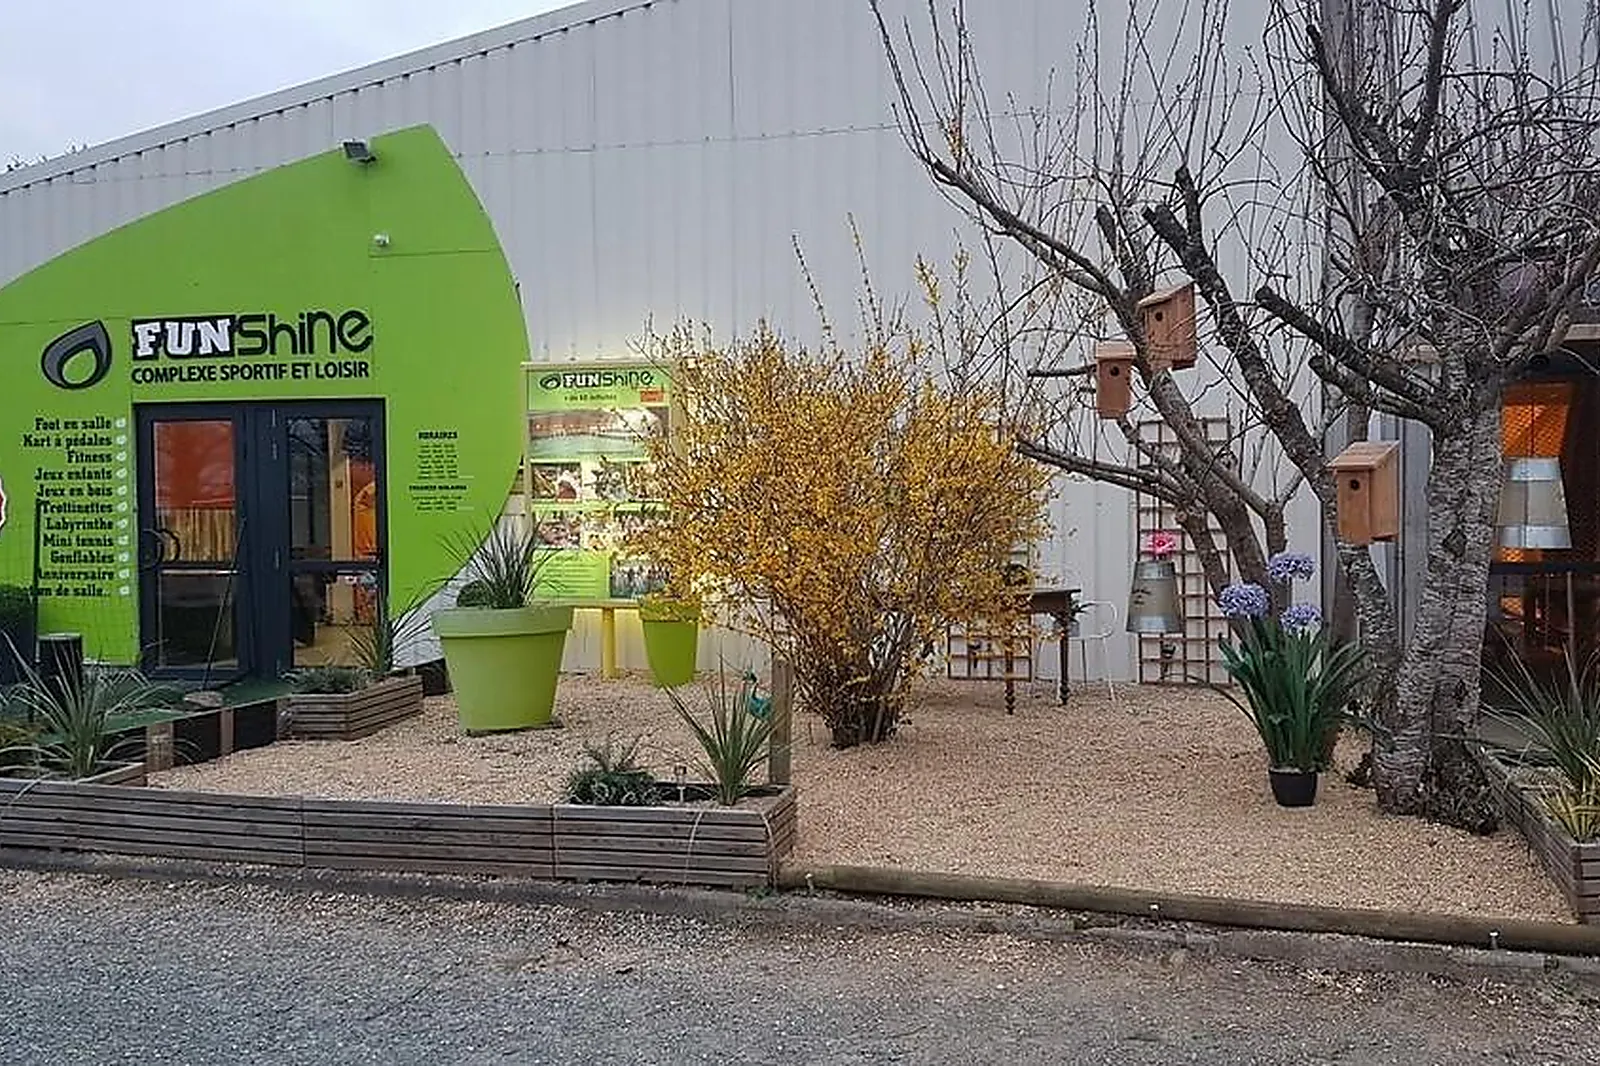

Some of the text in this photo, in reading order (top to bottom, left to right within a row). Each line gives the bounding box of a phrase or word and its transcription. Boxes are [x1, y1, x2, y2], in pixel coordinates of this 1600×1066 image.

[131, 361, 370, 384] COMPLEXE SPORTIF ET LOISIR
[35, 416, 112, 430] Foot en salle
[23, 434, 51, 447] Kart
[67, 451, 112, 463] Fitness
[35, 467, 112, 480] Jeux enfants
[37, 484, 113, 497] Jeux en bois
[39, 501, 113, 514] Trottinettes
[46, 517, 114, 533] Labyrinthe
[43, 534, 114, 547] Mini tennis
[50, 551, 114, 563] Gonflables
[55, 583, 70, 596] de
